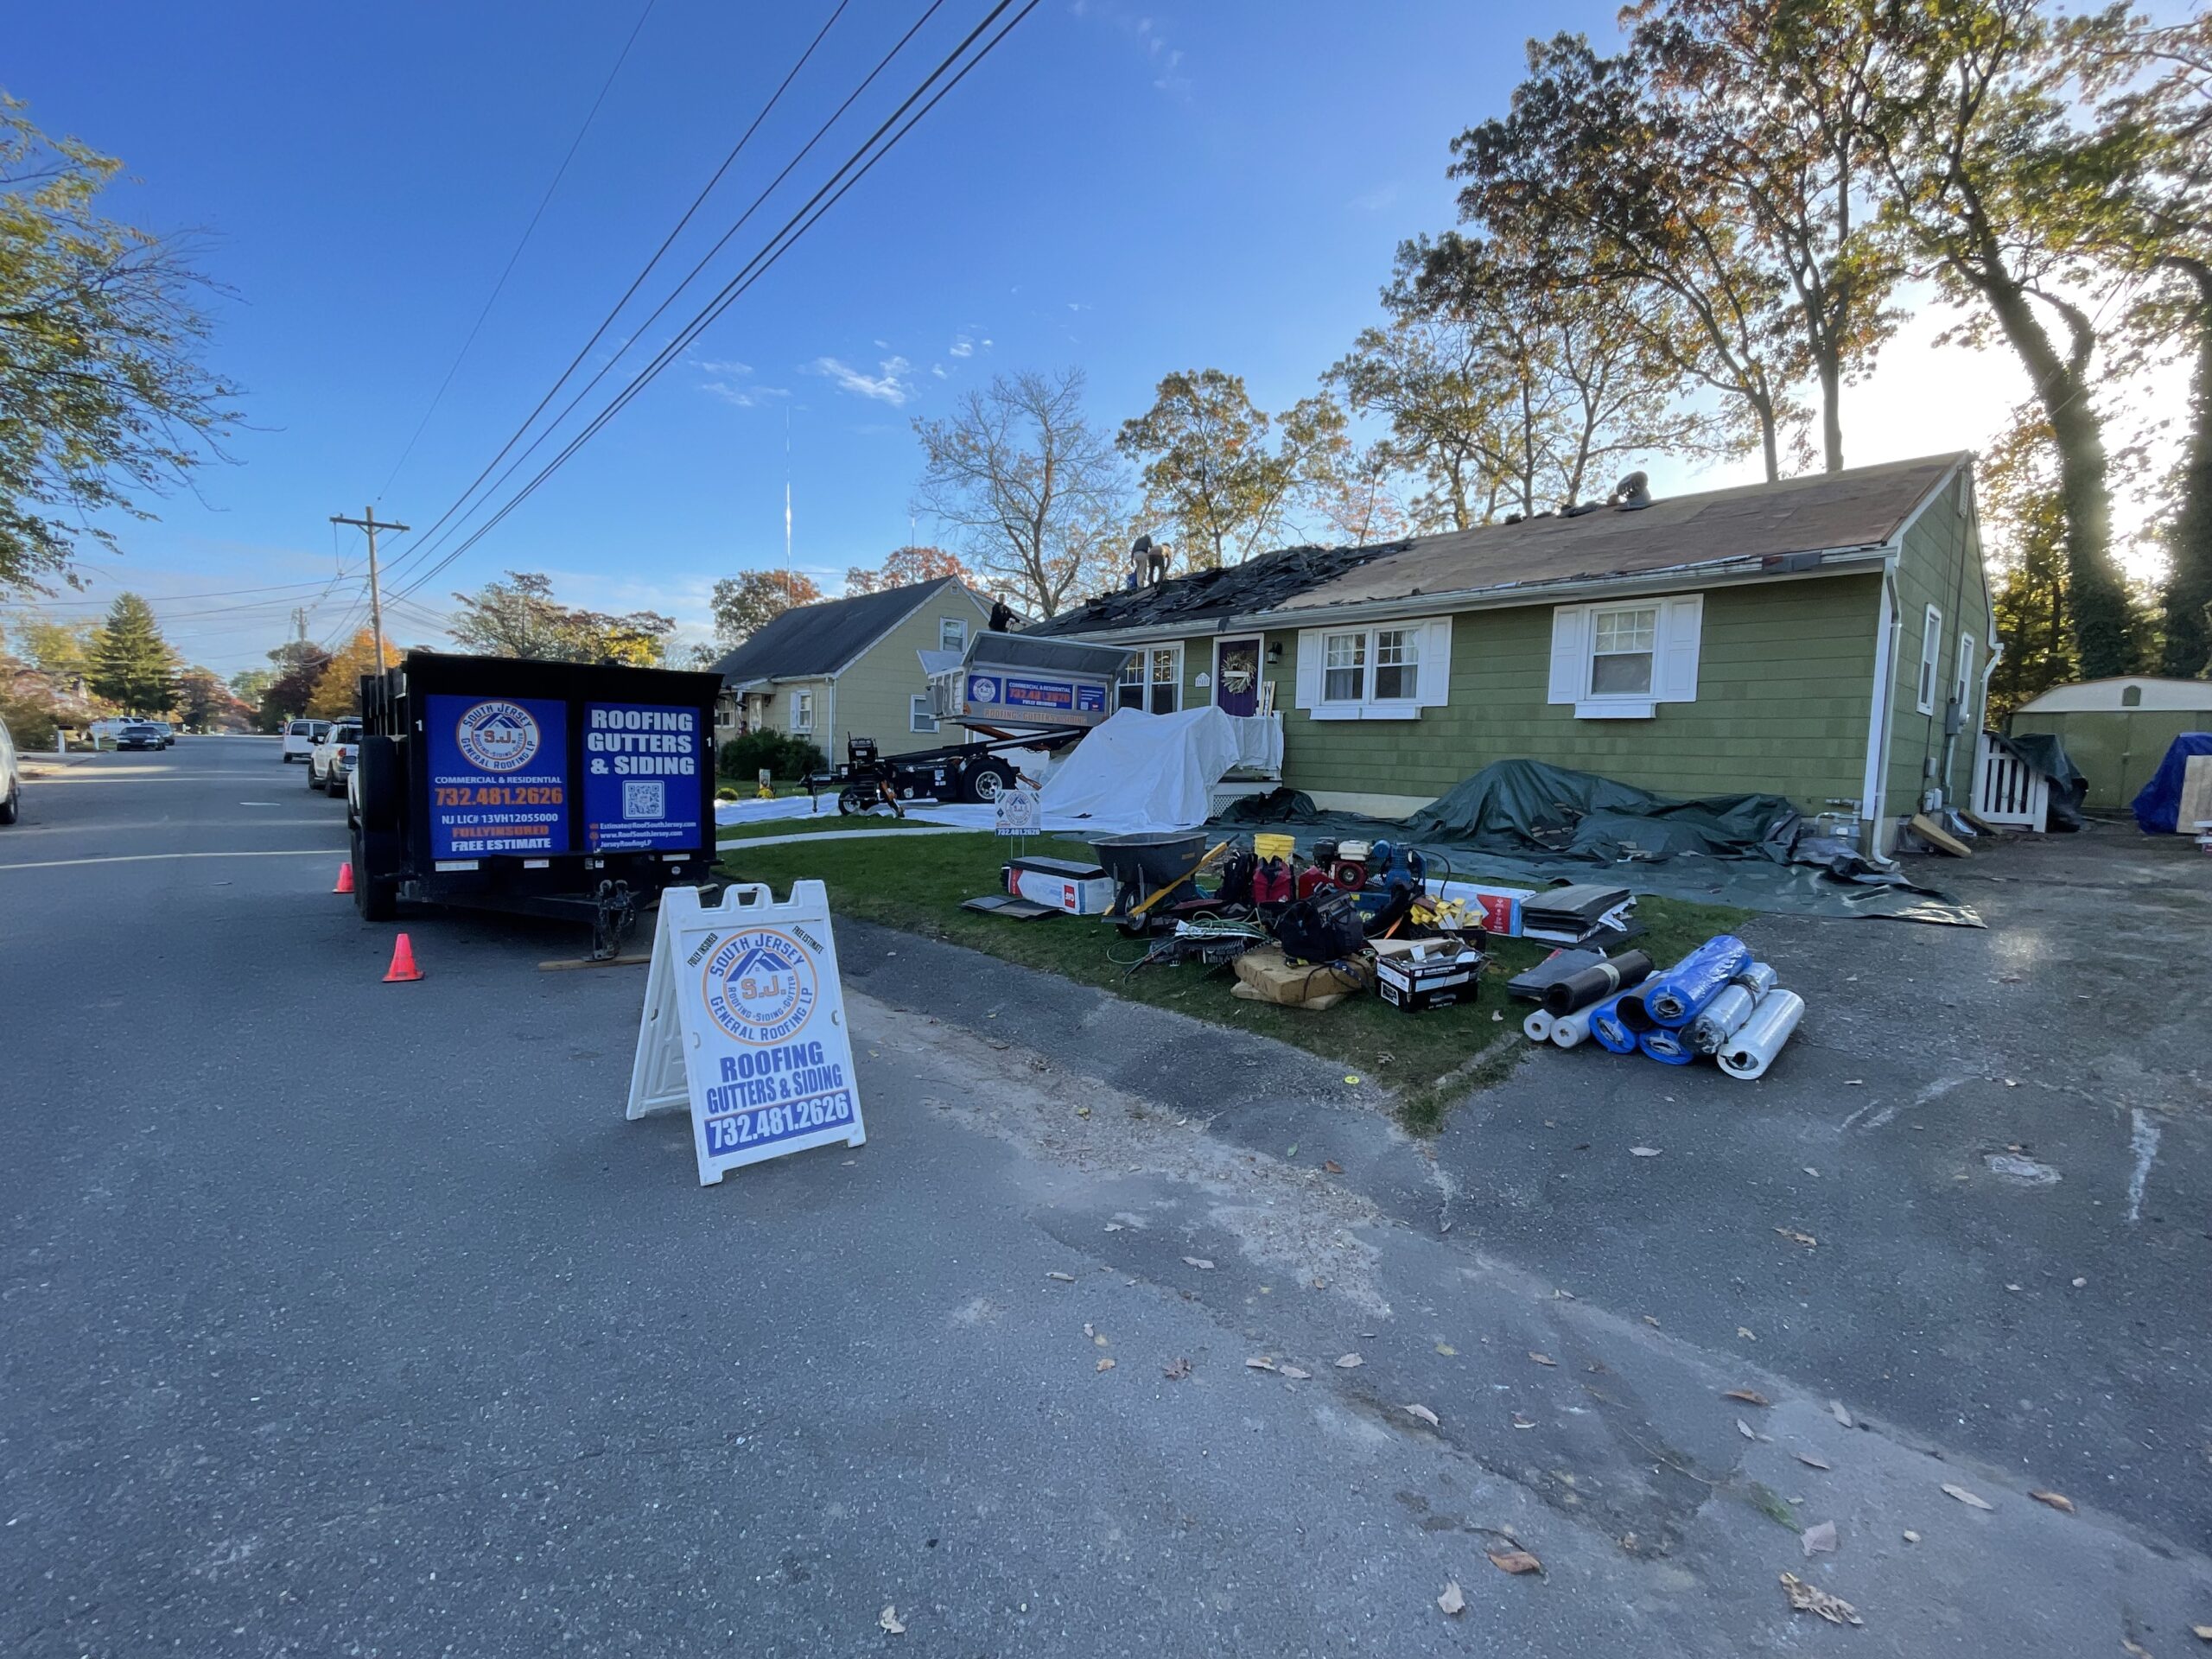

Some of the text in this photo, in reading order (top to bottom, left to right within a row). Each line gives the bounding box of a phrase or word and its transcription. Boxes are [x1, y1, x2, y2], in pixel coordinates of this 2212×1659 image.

[463, 703, 532, 727] SOUTH JERSEY
[591, 709, 693, 731] ROOFING
[484, 731, 516, 743] S.J.
[588, 733, 691, 753] GUTTERS
[461, 738, 535, 769] GENERAL ROOFING LP
[591, 756, 694, 774] & SIDING
[435, 787, 563, 806] 732.481.2626
[442, 813, 558, 824] NJ LIC# 13VH12055000
[452, 838, 551, 851] FREE ESTIMATE
[601, 840, 652, 849] JerseyRoofingLP
[687, 932, 718, 968] FULLY INSURED
[791, 926, 824, 954] FREE ESTIMATE
[710, 933, 804, 977] SOUTH JERSEY
[728, 976, 795, 1021] ROOFING SIDING GUTTER
[741, 975, 786, 1000] S.J.
[711, 988, 813, 1040] GENERAL ROOFING LP
[720, 1041, 823, 1083] ROOFING
[707, 1064, 842, 1115] GUTTERS & SIDING
[710, 1093, 849, 1149] 732.481.2626
